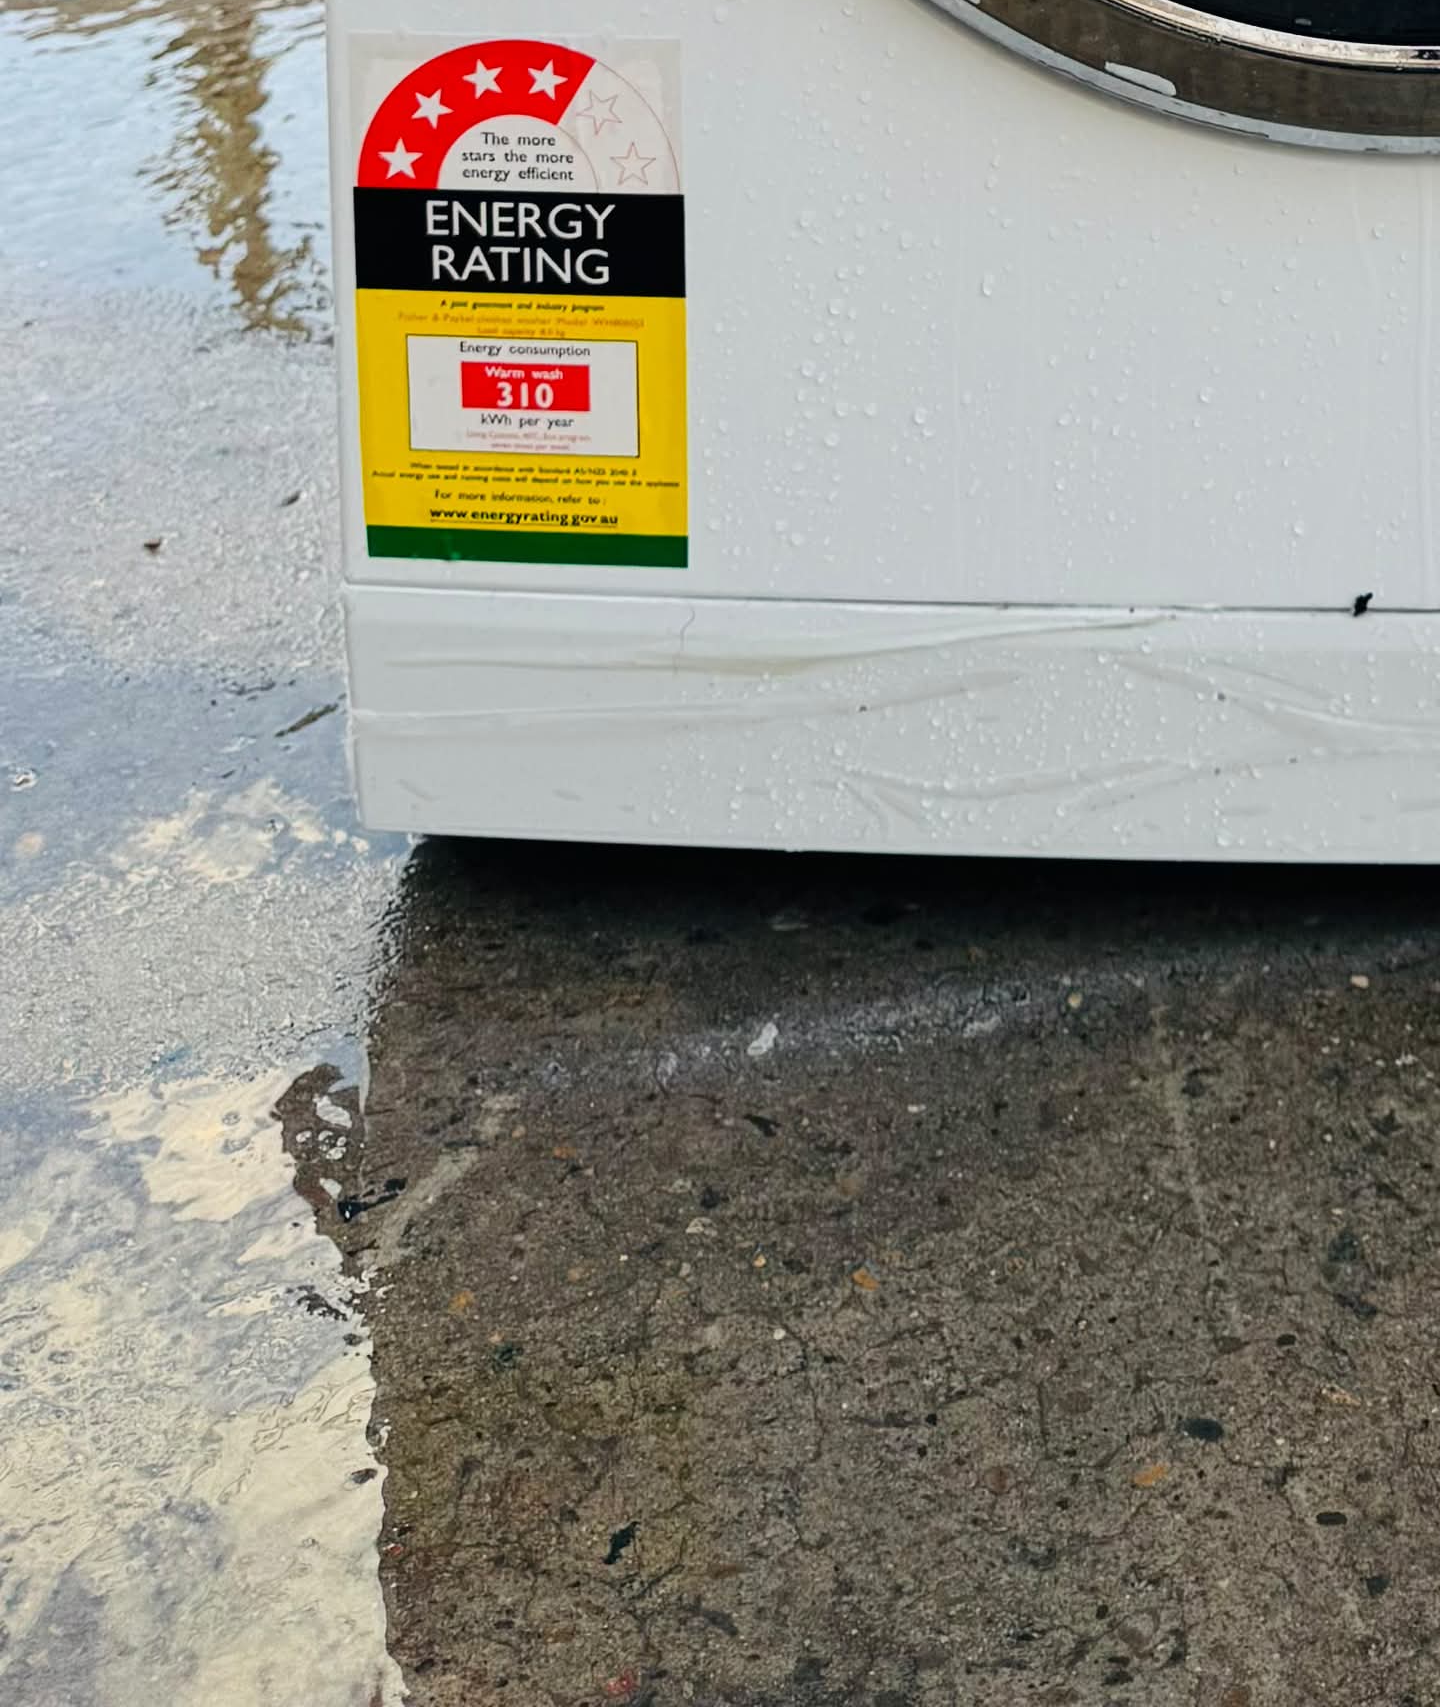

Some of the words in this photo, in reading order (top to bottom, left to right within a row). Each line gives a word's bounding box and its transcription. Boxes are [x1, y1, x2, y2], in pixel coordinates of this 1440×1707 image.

[481, 132, 509, 145] The
[517, 134, 556, 146] more
[462, 151, 495, 162] stars
[504, 149, 527, 163] the
[536, 151, 574, 164] more
[462, 169, 510, 182] energy
[518, 167, 574, 181] efficient
[426, 200, 616, 240] ENERGY
[432, 244, 610, 285] RATING
[460, 341, 502, 356] Energy
[509, 344, 591, 358] consumption
[485, 366, 525, 379] Warm
[531, 368, 564, 380] wash
[496, 381, 554, 409] 310
[481, 414, 512, 426] kWh
[519, 418, 540, 429] per
[547, 419, 575, 430] year
